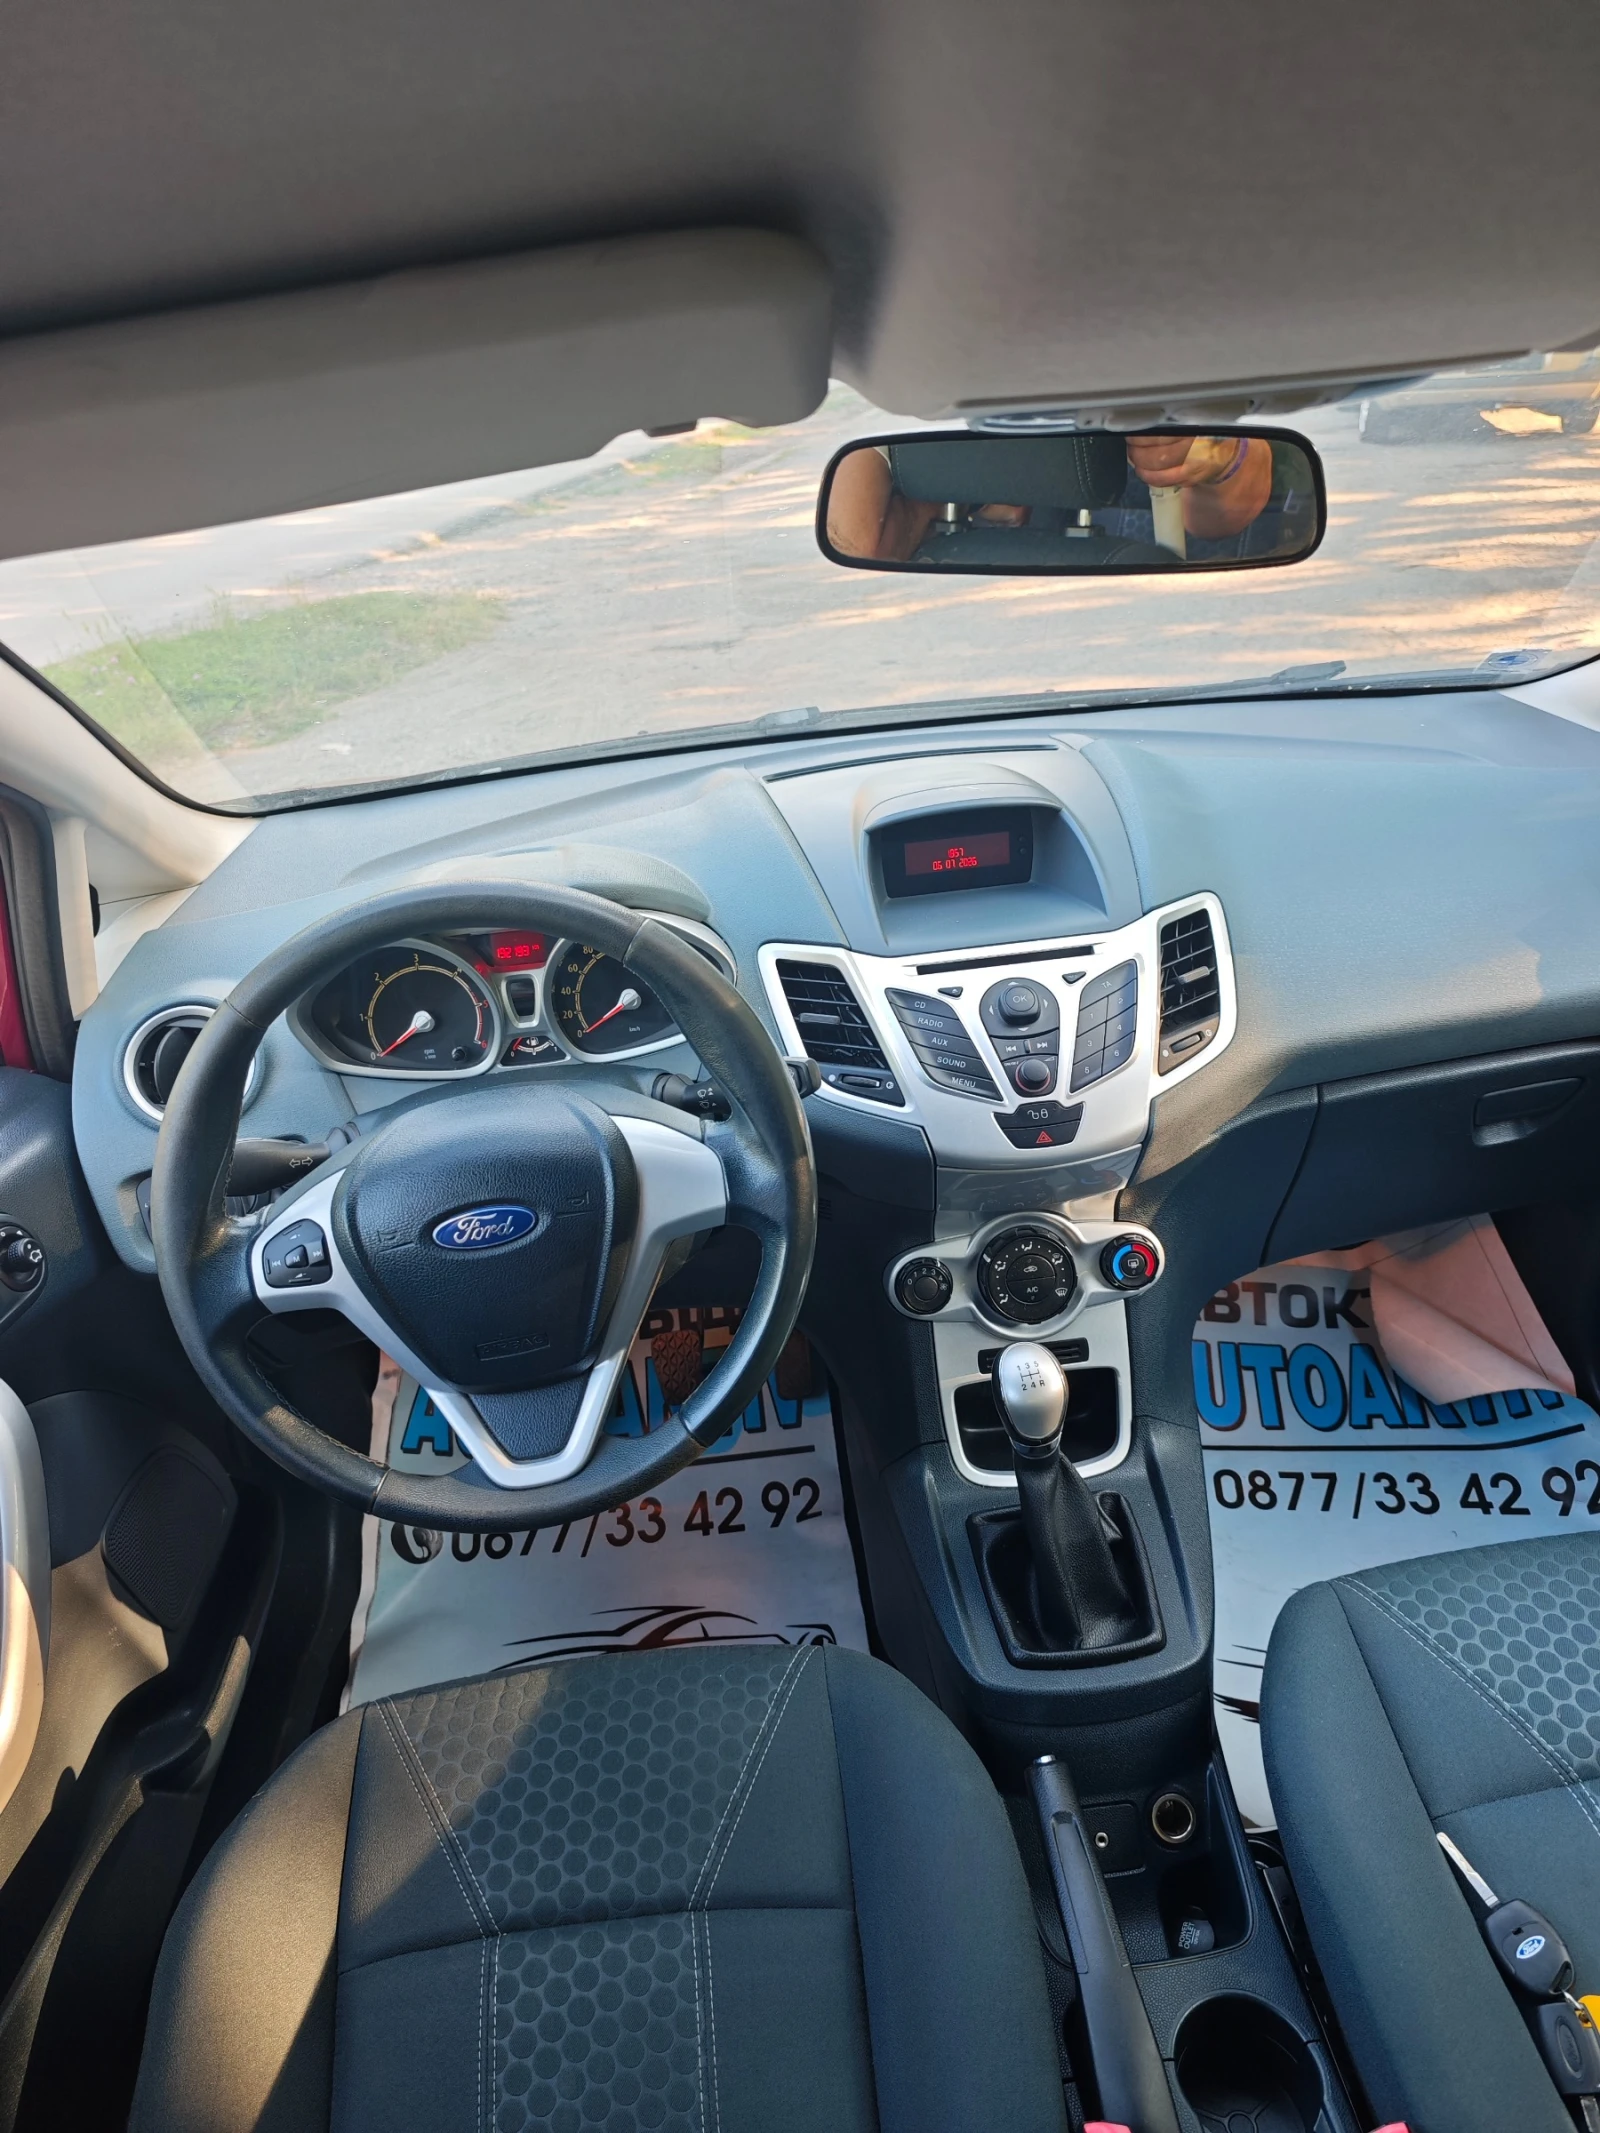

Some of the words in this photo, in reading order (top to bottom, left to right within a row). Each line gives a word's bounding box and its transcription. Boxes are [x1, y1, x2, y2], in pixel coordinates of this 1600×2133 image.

[583, 946, 593, 955] 80
[413, 953, 419, 963] 3
[567, 963, 578, 973] 60
[374, 972, 380, 981] 2
[1101, 981, 1113, 989] TA
[560, 986, 571, 995] 40
[483, 999, 489, 1008] 5
[1012, 995, 1028, 1003] OK
[914, 1001, 926, 1009] CD
[562, 1009, 573, 1019] 20
[917, 1017, 944, 1028] RADIO
[577, 1029, 583, 1038] 0
[481, 1040, 487, 1049] 6
[931, 1037, 949, 1047] AUX
[370, 1052, 376, 1060] 0
[937, 1056, 967, 1068] SOUND
[1084, 1066, 1090, 1074] 5
[951, 1076, 976, 1088] MENU
[453, 1213, 514, 1244] Ford
[293, 1255, 300, 1263] M
[922, 1267, 927, 1275] 2
[931, 1268, 936, 1276] 3
[1026, 1285, 1039, 1293] A/C
[1197, 1280, 1371, 1329] ВТОК
[1033, 1360, 1039, 1368] 5
[1021, 1383, 1028, 1391] 2
[1039, 1379, 1046, 1387] R
[1213, 1468, 1440, 1520] 0877/33
[1459, 1472, 1531, 1515] 42
[1541, 1459, 1600, 1517] 92
[683, 1486, 746, 1536] 42
[761, 1477, 822, 1529] 92
[1178, 1921, 1189, 1948] POWER
[1183, 1921, 1195, 1950] OUTLET
